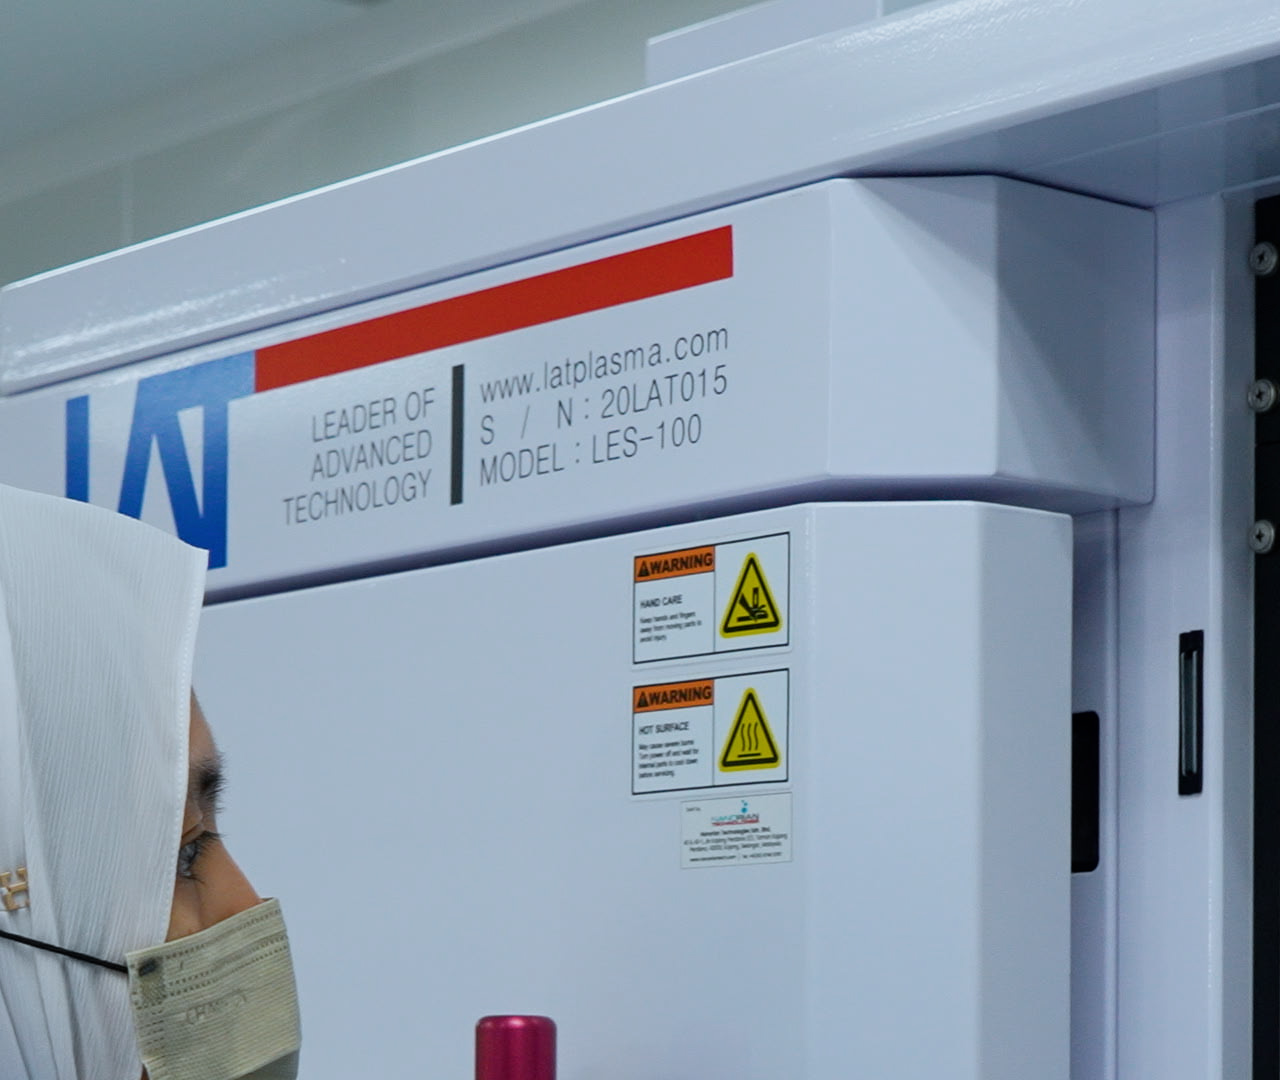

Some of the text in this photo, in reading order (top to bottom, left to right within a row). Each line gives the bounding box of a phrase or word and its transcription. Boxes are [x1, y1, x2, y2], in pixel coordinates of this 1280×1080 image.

[480, 326, 729, 403] www.latplasma.com
[312, 387, 436, 443] LEADER OF
[601, 365, 728, 419] 20LAT015
[311, 429, 432, 482] ADVANCED
[480, 445, 564, 487] MODEL
[592, 414, 702, 464] LES-100
[283, 469, 432, 526] TECHNOLOGY
[650, 553, 712, 575] WARNING
[640, 595, 682, 609] HAND CARE
[648, 686, 711, 706] WARNING
[639, 721, 689, 735] HOT SURFACE
